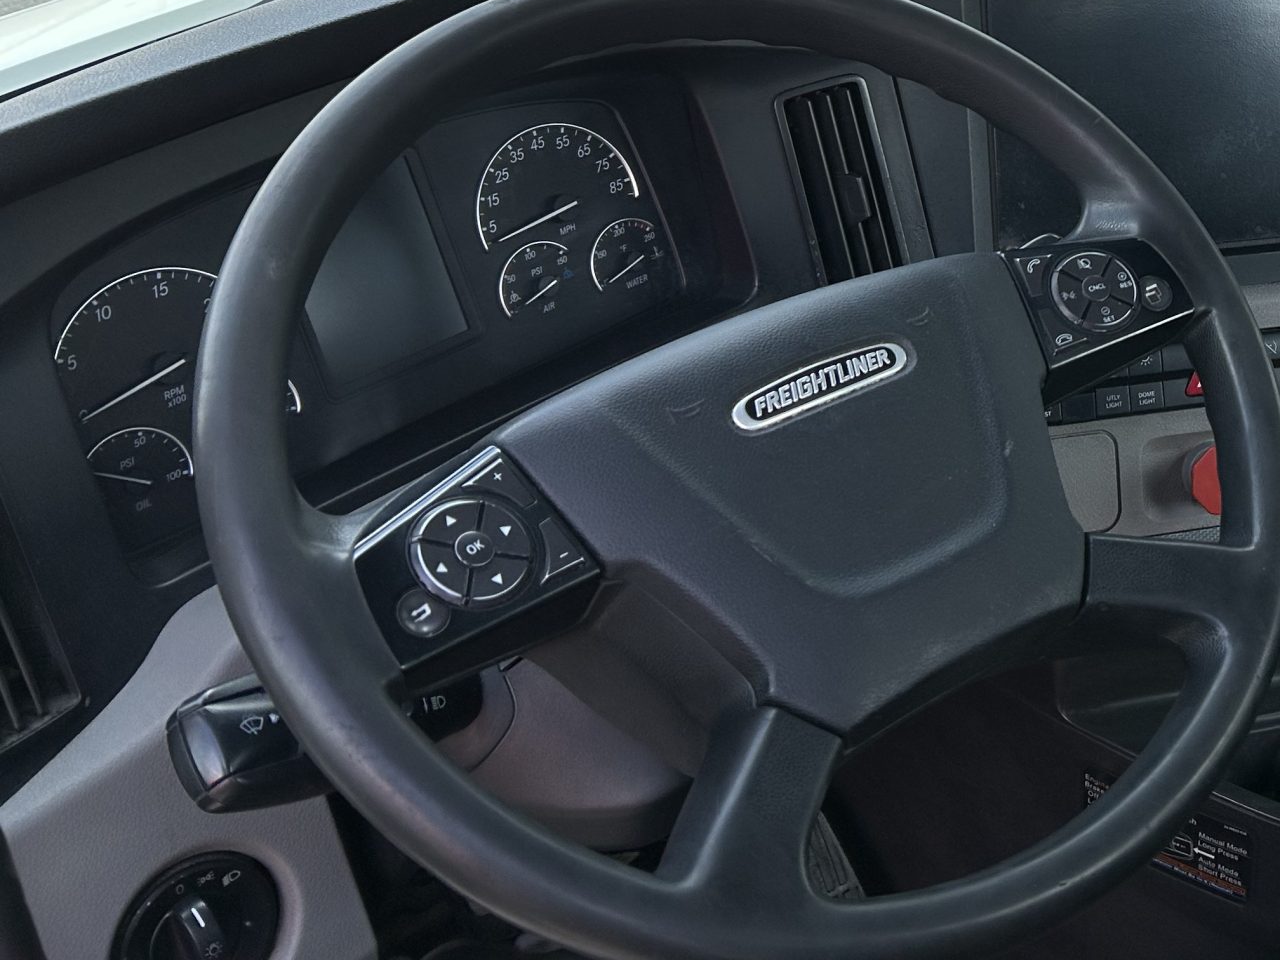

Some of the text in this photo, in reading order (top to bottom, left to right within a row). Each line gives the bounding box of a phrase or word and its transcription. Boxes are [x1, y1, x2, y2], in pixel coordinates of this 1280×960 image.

[530, 136, 545, 151] 45
[555, 134, 570, 150] 55
[509, 149, 525, 164] 35
[577, 143, 592, 159] 65
[595, 158, 610, 174] 75
[494, 167, 510, 184] 25
[609, 178, 624, 194] 85
[487, 193, 500, 208] 15
[488, 220, 497, 233] 5
[559, 223, 577, 236] MPH
[613, 226, 625, 238] 200
[524, 250, 536, 261] 100
[557, 255, 568, 266] 150
[506, 273, 516, 284] 50
[530, 265, 543, 278] PSI
[625, 273, 648, 289] WATER
[1088, 282, 1107, 293] CNCL
[1119, 279, 1133, 289] RES
[151, 281, 169, 299] 15
[94, 304, 112, 323] 10
[543, 301, 556, 314] AIR
[1102, 314, 1115, 323] SET
[66, 354, 78, 371] 5
[753, 348, 892, 419] FREIGHTLINER
[163, 384, 185, 401] RPM
[1105, 393, 1121, 402] UTLY
[1137, 390, 1156, 399] DOME
[167, 394, 187, 409] x100
[1105, 401, 1122, 409] LIGHT
[1138, 397, 1156, 406] LIGHT
[133, 435, 147, 448] 50
[119, 456, 135, 471] PSI
[165, 469, 182, 482] 100
[135, 498, 153, 512] OIL
[465, 539, 485, 555] OK
[1197, 839, 1240, 862] Long Press
[1198, 831, 1248, 856] Manual Mode
[1197, 856, 1217, 869] Auto
[1217, 863, 1240, 878] Mode
[1197, 862, 1219, 878] Short
[1219, 872, 1243, 887] Press
